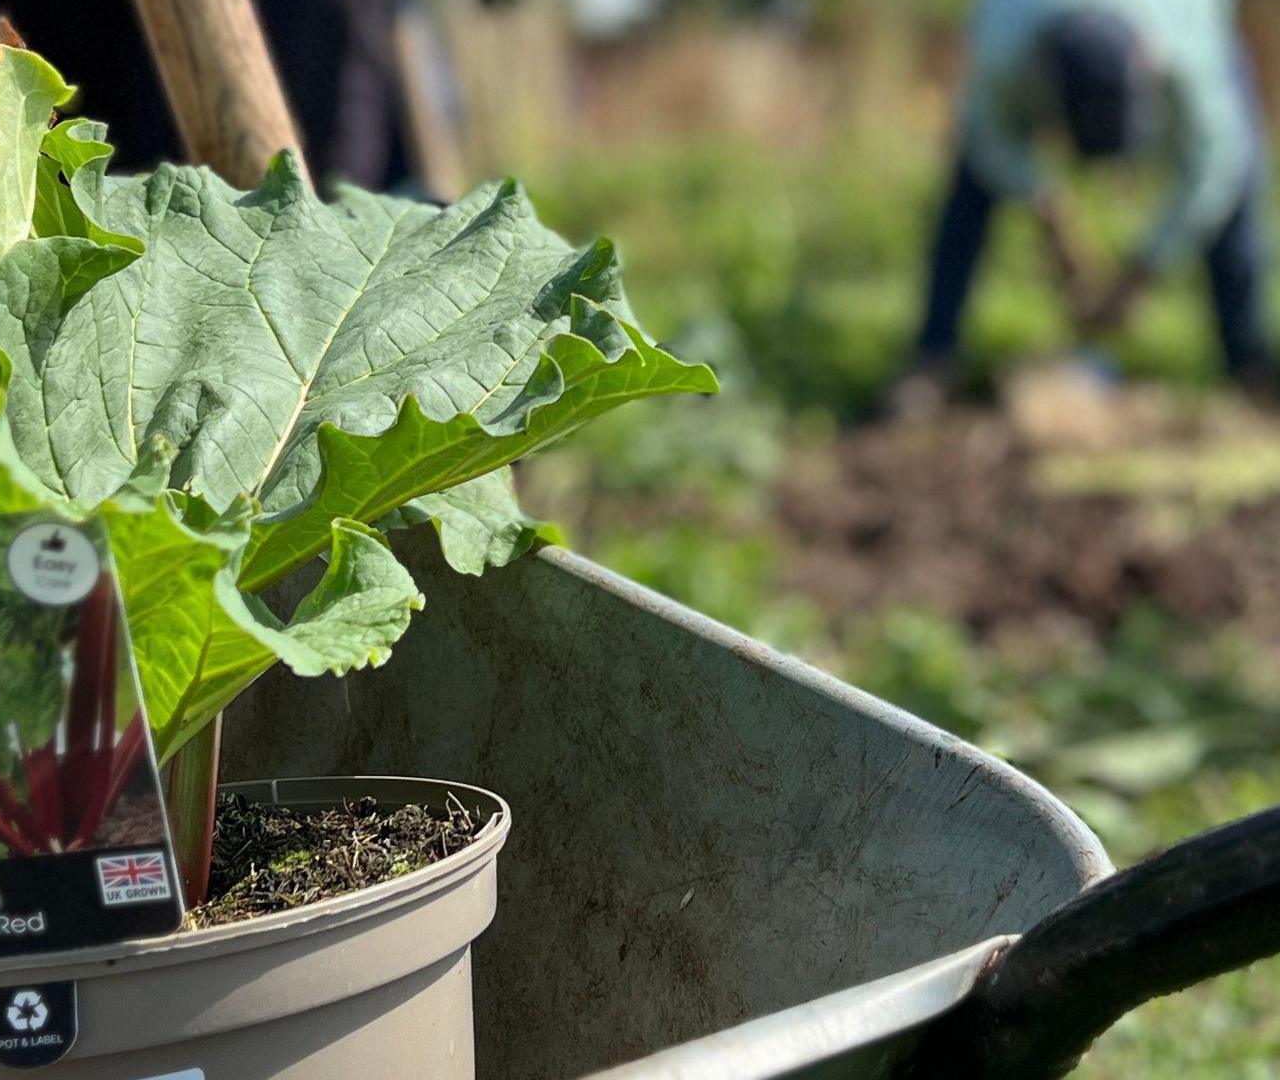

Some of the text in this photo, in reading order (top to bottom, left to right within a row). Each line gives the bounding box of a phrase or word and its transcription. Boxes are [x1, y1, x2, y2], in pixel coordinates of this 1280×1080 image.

[107, 886, 167, 900] UK GROWN
[21, 1037, 29, 1047] &
[31, 1034, 64, 1046] LABEL
